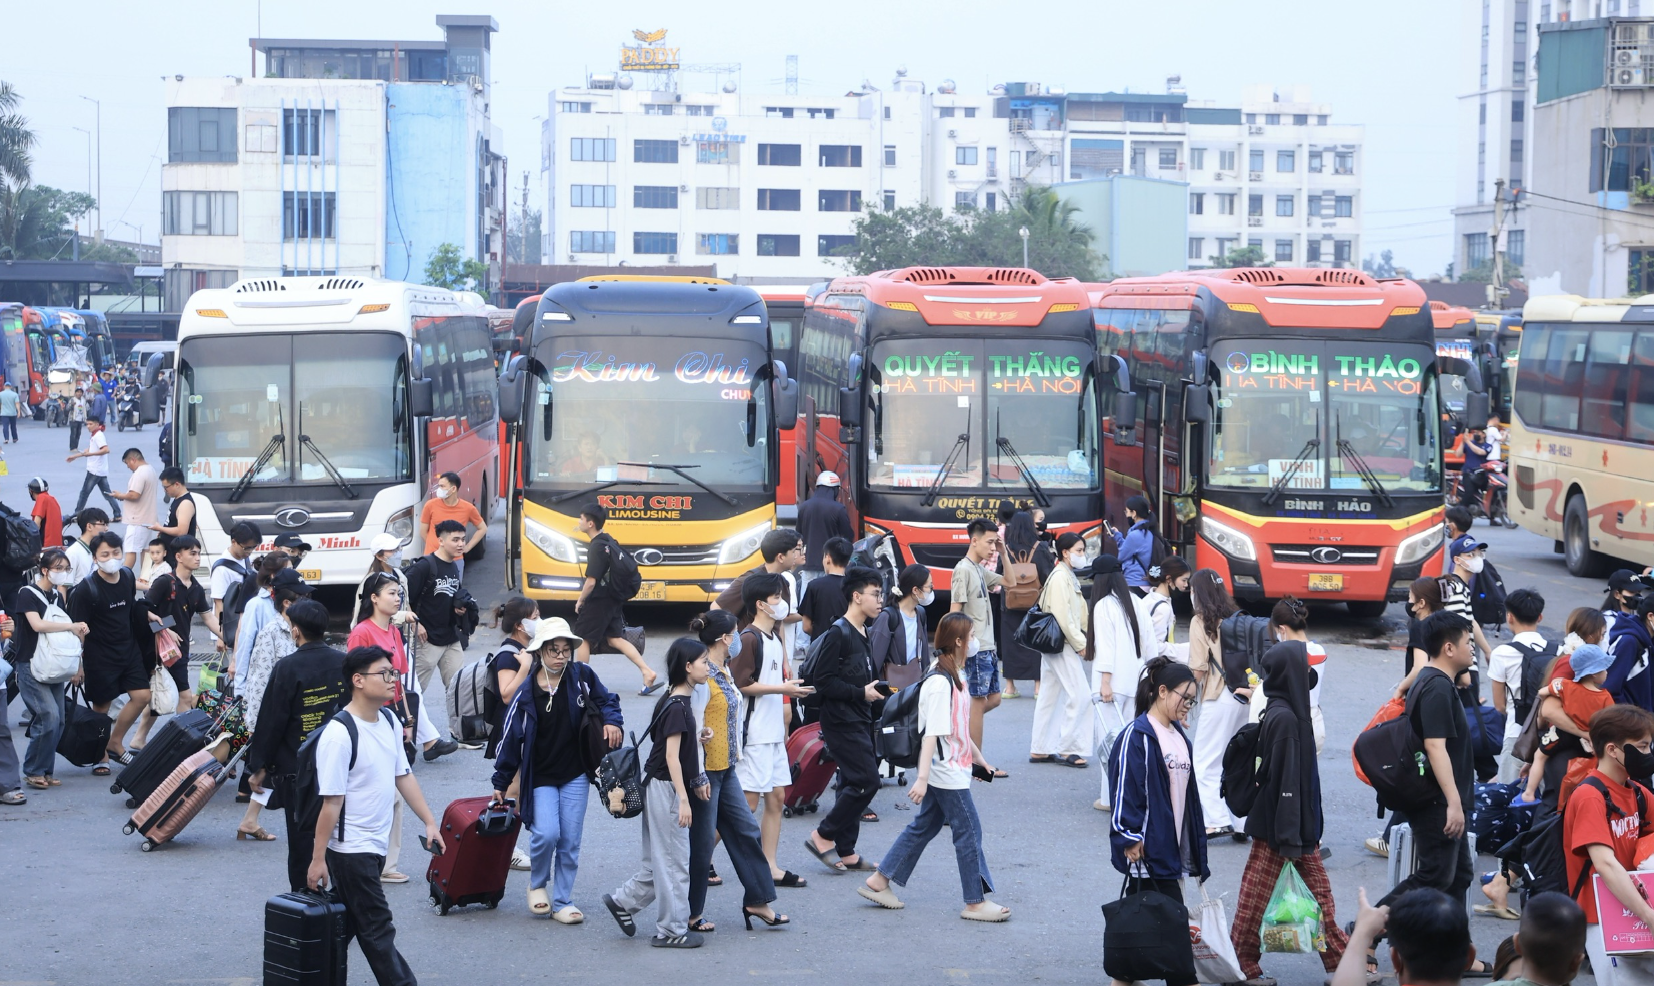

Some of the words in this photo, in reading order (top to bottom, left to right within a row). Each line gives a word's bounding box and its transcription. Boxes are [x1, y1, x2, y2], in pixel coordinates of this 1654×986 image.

[621, 47, 680, 64] PADDY
[553, 350, 660, 383] Kim
[675, 351, 751, 385] Chi
[884, 351, 975, 377] QUYẾT
[988, 352, 1081, 377] THẮNG
[1250, 350, 1319, 375] BÌNH
[1334, 354, 1421, 379] THẢO
[923, 377, 976, 393] TĨNH
[1003, 377, 1036, 393] HÀ
[1263, 374, 1316, 391] TĨNH
[597, 495, 645, 509] KIM
[649, 496, 692, 509] CHI
[1284, 498, 1324, 510] BÌNH
[608, 510, 680, 519] LIMOUSINE
[318, 536, 361, 549] Minh
